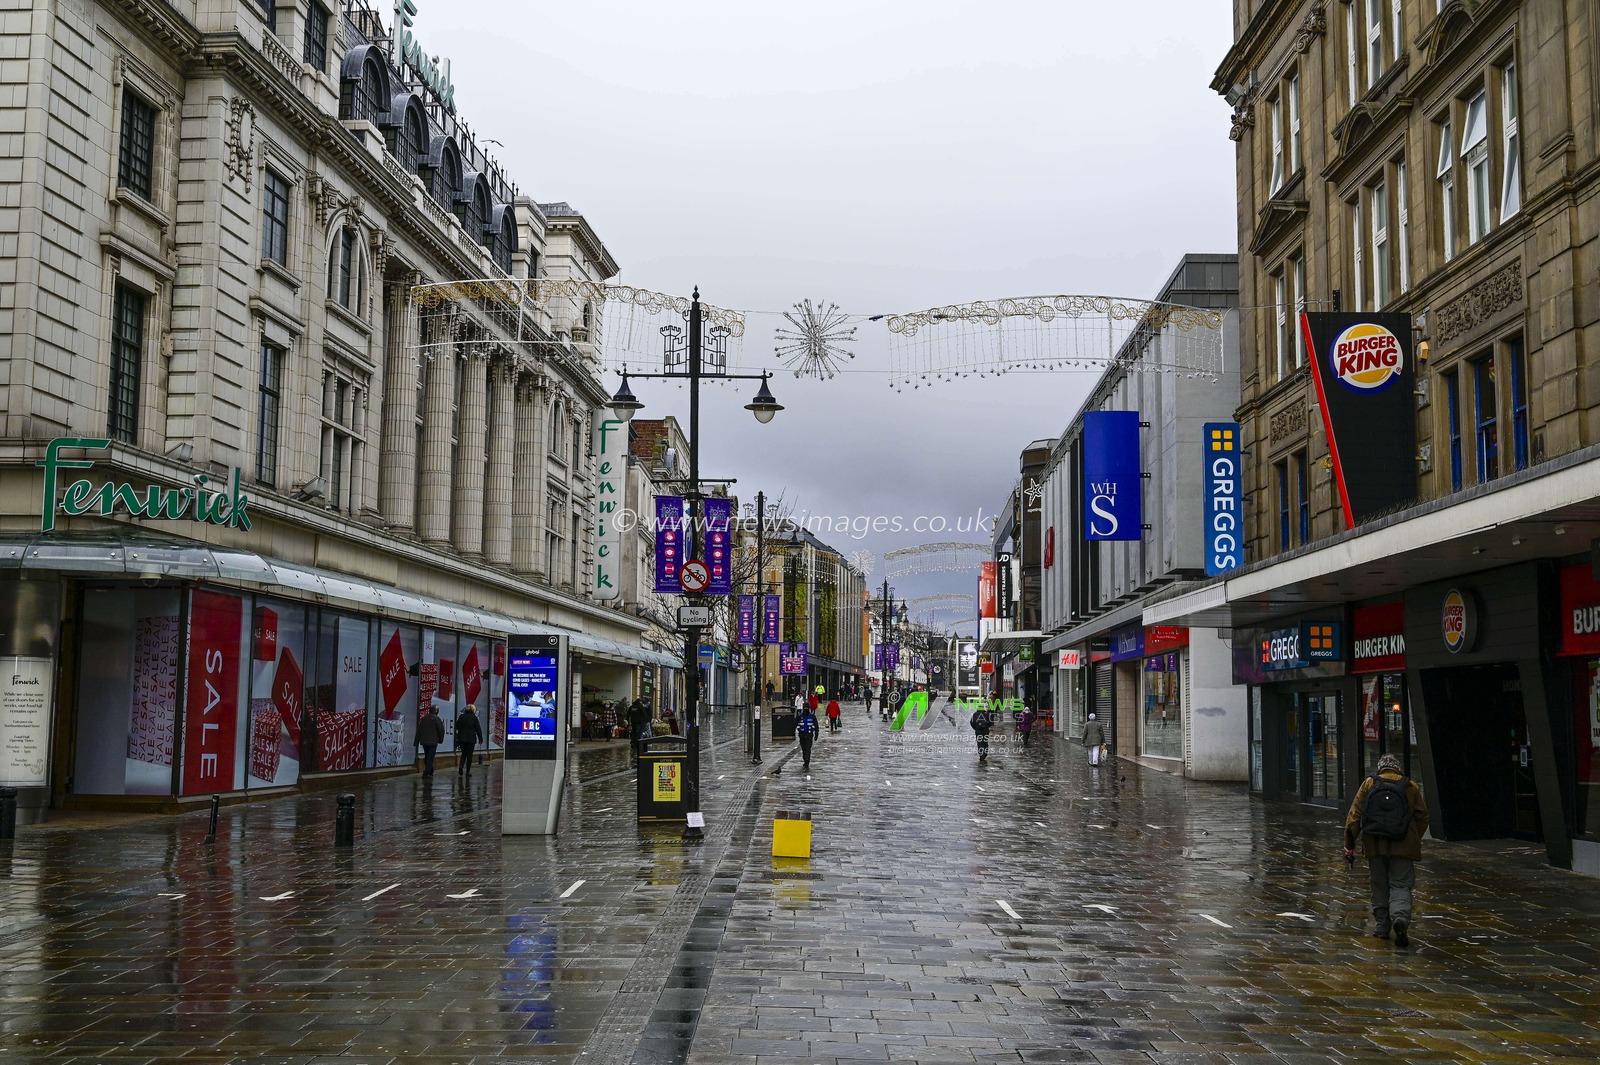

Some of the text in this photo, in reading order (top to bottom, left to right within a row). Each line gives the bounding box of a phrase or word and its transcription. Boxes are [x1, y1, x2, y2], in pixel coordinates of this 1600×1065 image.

[392, 0, 458, 116] Fenwick
[1337, 336, 1396, 358] BURGER
[1338, 348, 1398, 377] KING
[35, 437, 253, 532] Fenwick
[1091, 482, 1117, 495] WH
[596, 419, 624, 589] Fenwick
[1212, 458, 1236, 569] GREGGS
[1091, 495, 1118, 536] S
[998, 554, 1010, 562] JD
[682, 616, 707, 624] cycling
[1443, 605, 1463, 617] BURGER
[1443, 616, 1463, 632] KING
[265, 629, 275, 641] SALE
[1354, 637, 1388, 658] BURGER
[343, 656, 363, 673] SALE
[1061, 653, 1079, 665] H&M
[12, 675, 39, 686] Fenwick
[386, 657, 401, 688] SALE
[467, 666, 477, 689] SALE
[200, 649, 223, 779] SALE
[282, 681, 302, 731] SALE
[259, 723, 274, 738] SALE
[349, 715, 365, 743] SALE
[523, 721, 540, 731] LBC
[324, 725, 349, 761] SALE
[257, 752, 272, 767] SALE
